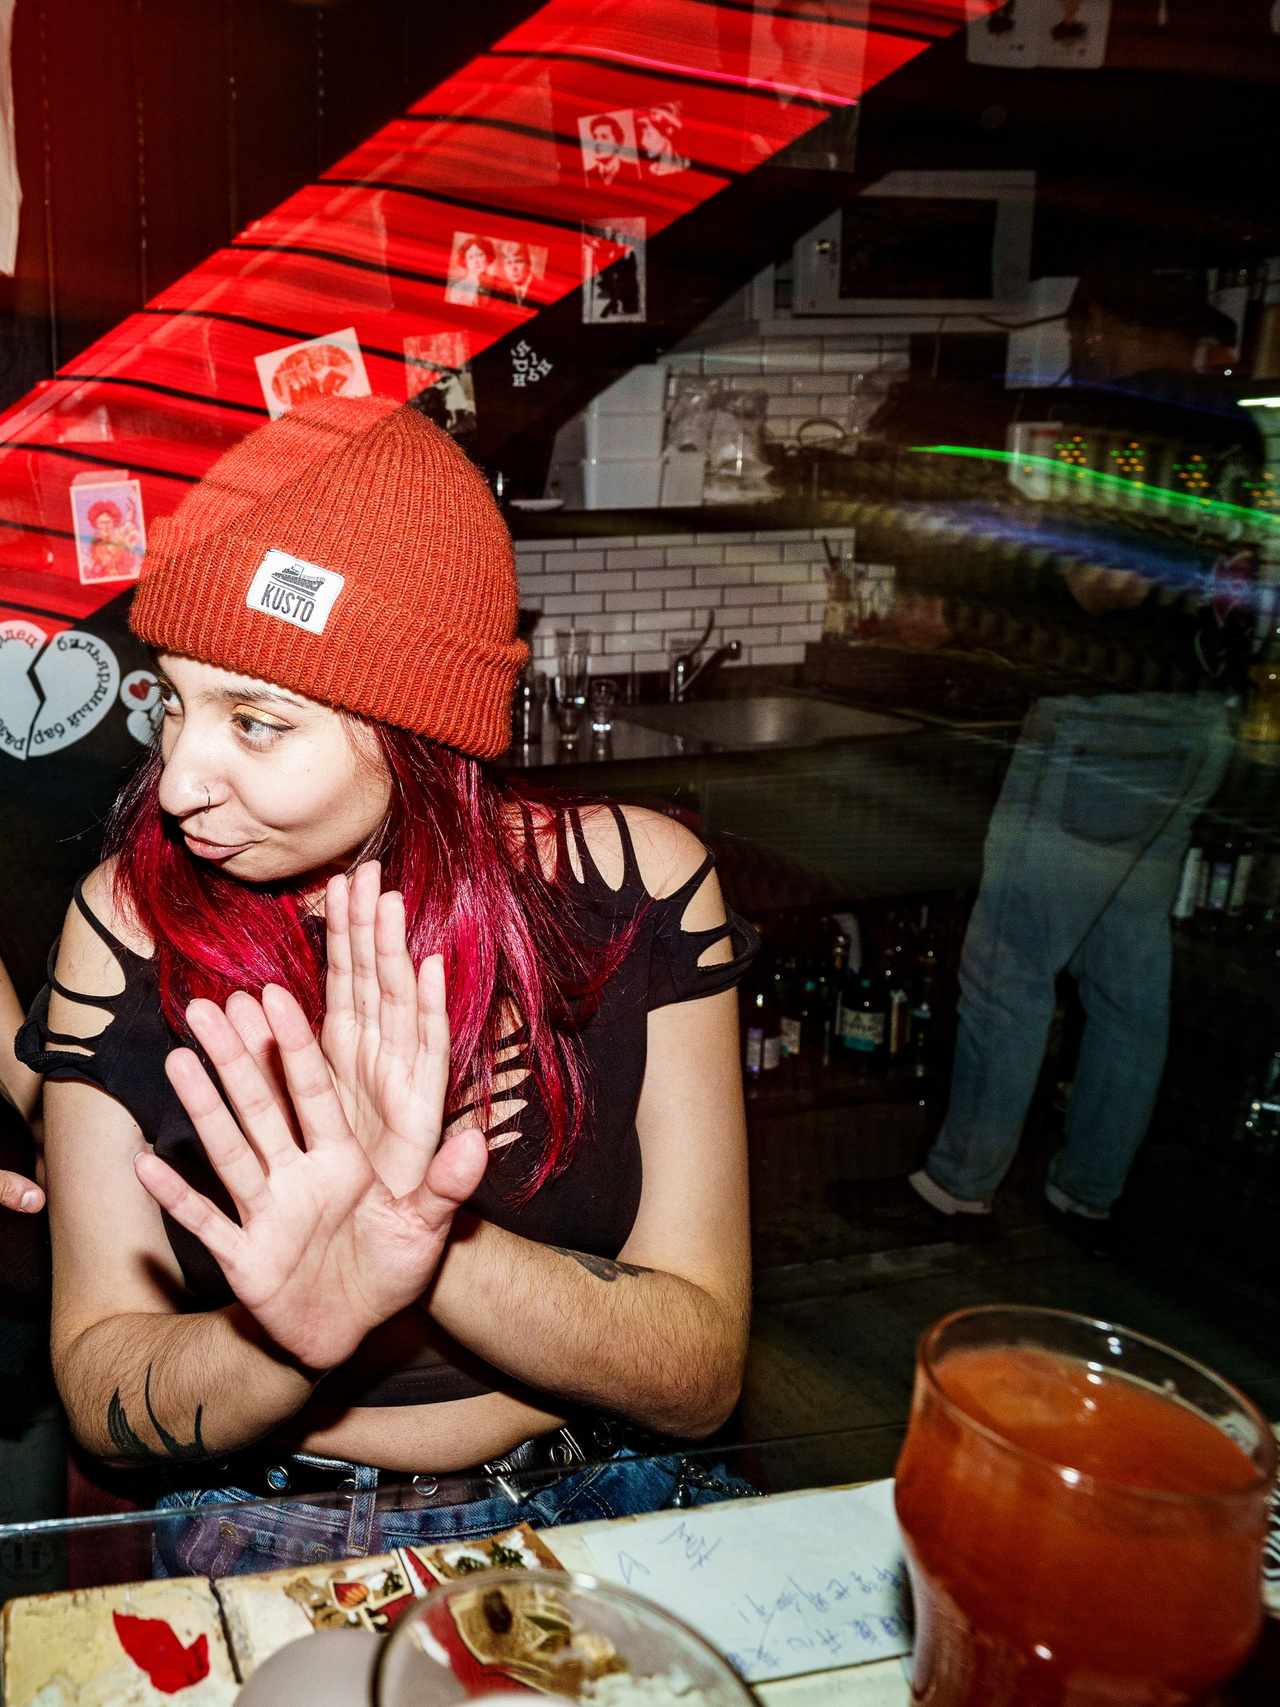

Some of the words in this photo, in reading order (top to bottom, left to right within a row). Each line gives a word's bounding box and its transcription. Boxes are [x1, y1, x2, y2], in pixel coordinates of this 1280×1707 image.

[261, 584, 314, 622] KUSTO
[57, 636, 111, 728] бильярдный
[33, 722, 66, 744] бар
